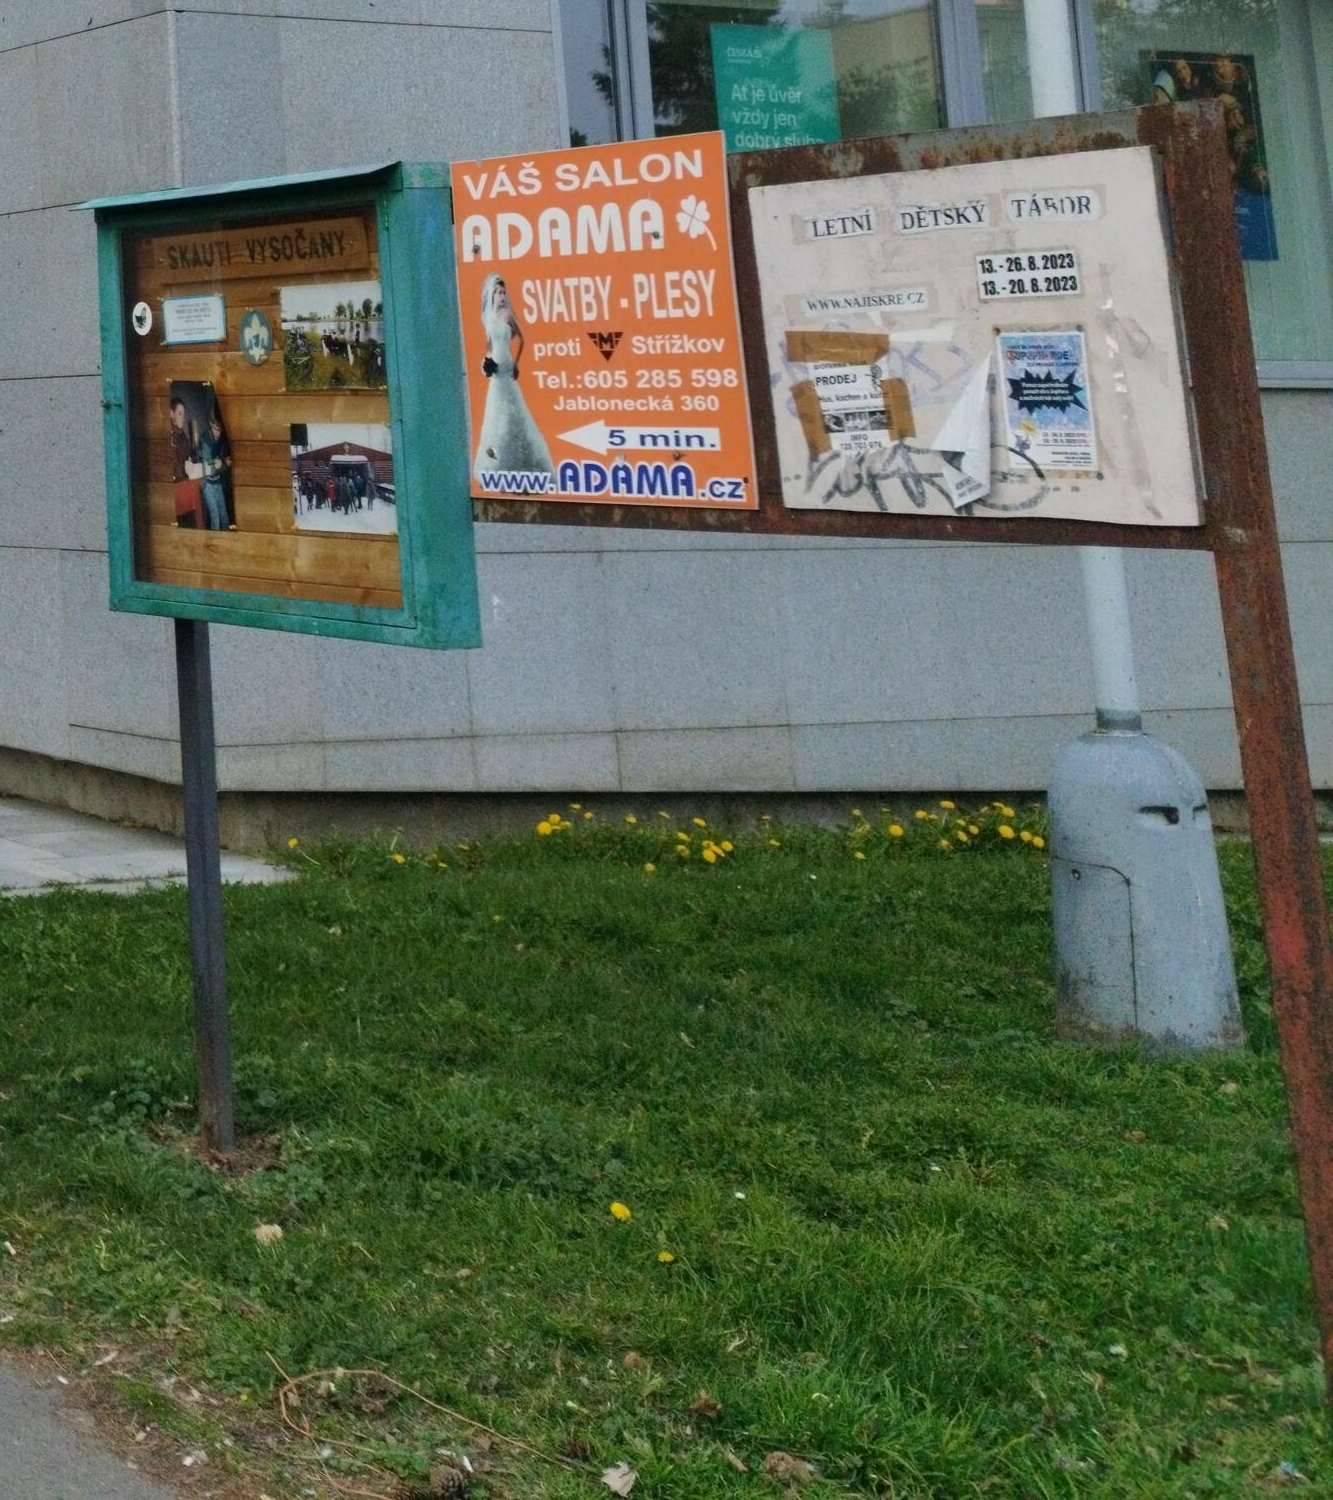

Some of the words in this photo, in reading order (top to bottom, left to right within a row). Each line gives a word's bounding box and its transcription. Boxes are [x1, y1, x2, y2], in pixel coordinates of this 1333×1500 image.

[751, 85, 765, 105] je
[769, 84, 803, 103] úvěr
[733, 108, 769, 130] vždy
[773, 109, 799, 130] jen
[463, 161, 542, 200] VÁŠ
[555, 149, 703, 192] SALON
[462, 198, 664, 262] ADAMA
[812, 209, 873, 238] LETNÍ
[901, 201, 986, 231] DĚTSKÝ
[167, 240, 232, 270] SKAUTI
[245, 227, 346, 264] VYSOČANY
[979, 258, 997, 274] 13.
[1006, 256, 1025, 273] 26.
[1028, 255, 1039, 271] 8.
[1041, 253, 1075, 271] 2023
[522, 275, 611, 324] SVATBY
[634, 269, 716, 319] PLESY
[982, 280, 1000, 296] 13.
[1009, 278, 1028, 295] 20.
[1044, 275, 1078, 293] 2023
[534, 337, 581, 361] proti
[632, 334, 725, 355] Střížkov
[637, 369, 682, 388] 285
[691, 368, 738, 388] 598
[815, 374, 857, 386] PRODEJ
[554, 395, 674, 412] Jablonecká
[681, 395, 720, 412] 360
[608, 429, 626, 447] 5
[639, 429, 717, 448] min.
[482, 460, 745, 499] www.ADAMA.cz
